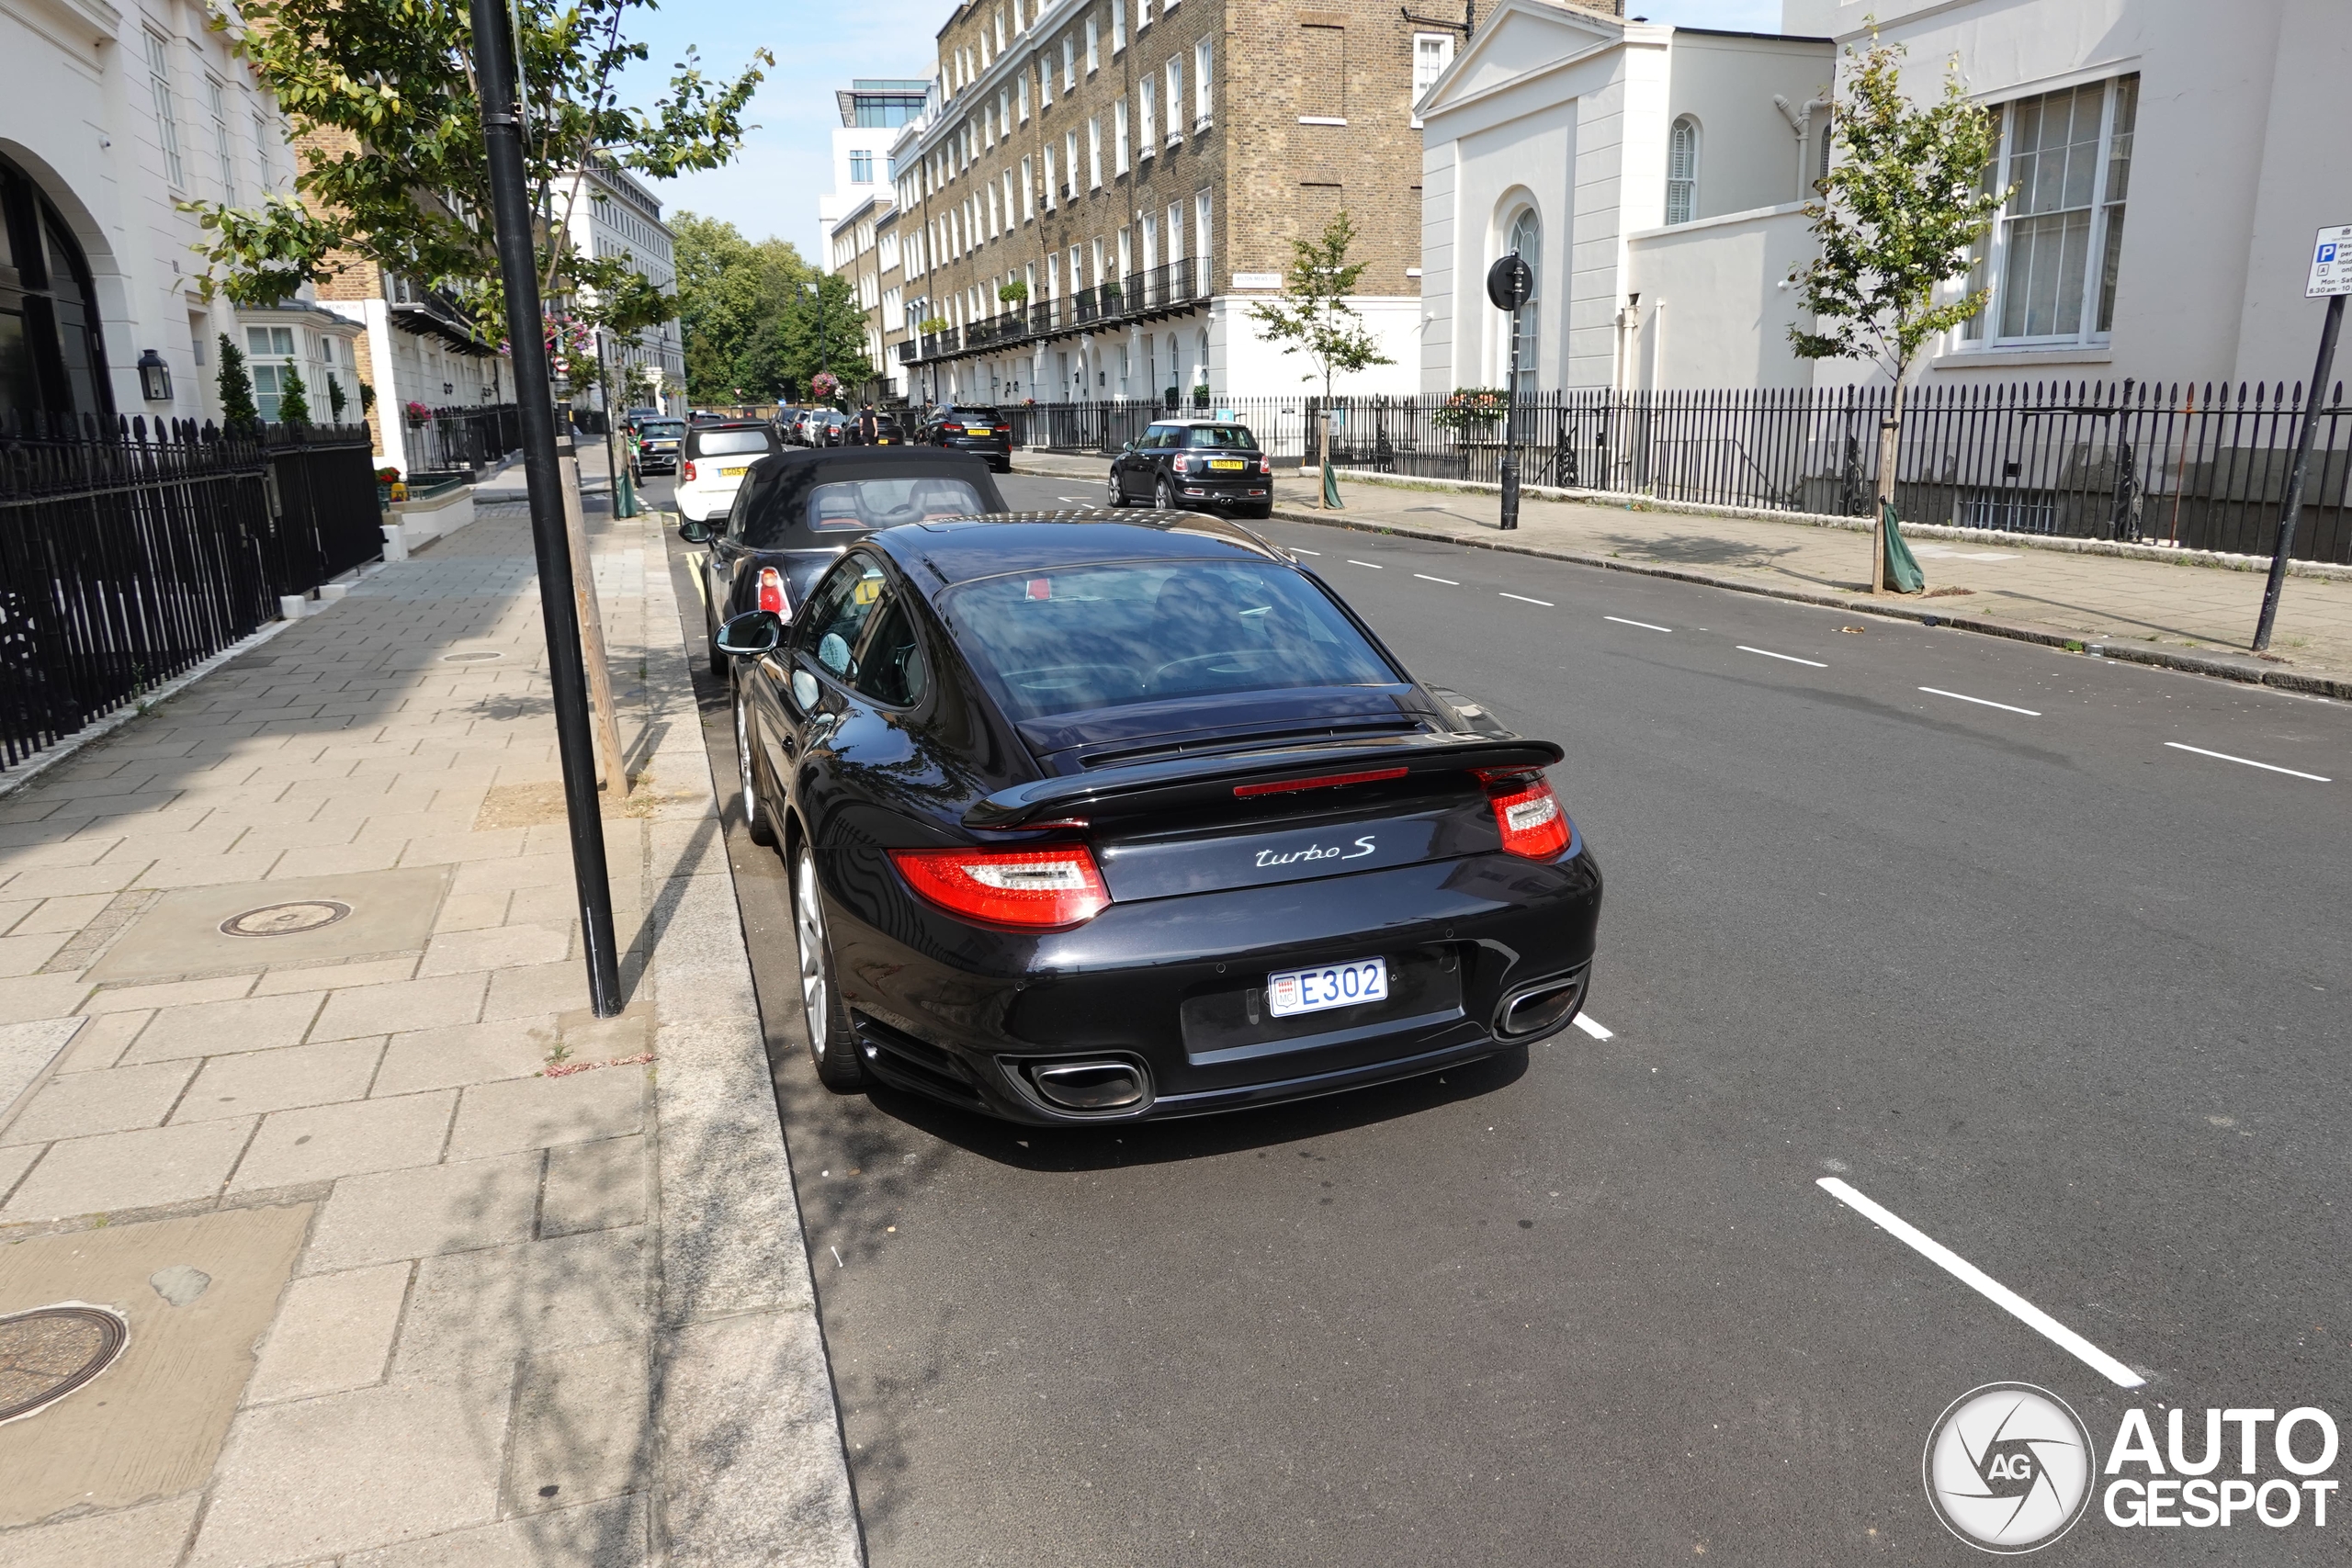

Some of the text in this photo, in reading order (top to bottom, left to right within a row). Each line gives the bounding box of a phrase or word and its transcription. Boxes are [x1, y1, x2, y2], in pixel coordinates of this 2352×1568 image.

[1256, 835, 1376, 867] turbo S
[1279, 993, 1294, 1003] MC
[1300, 964, 1381, 1006] E302
